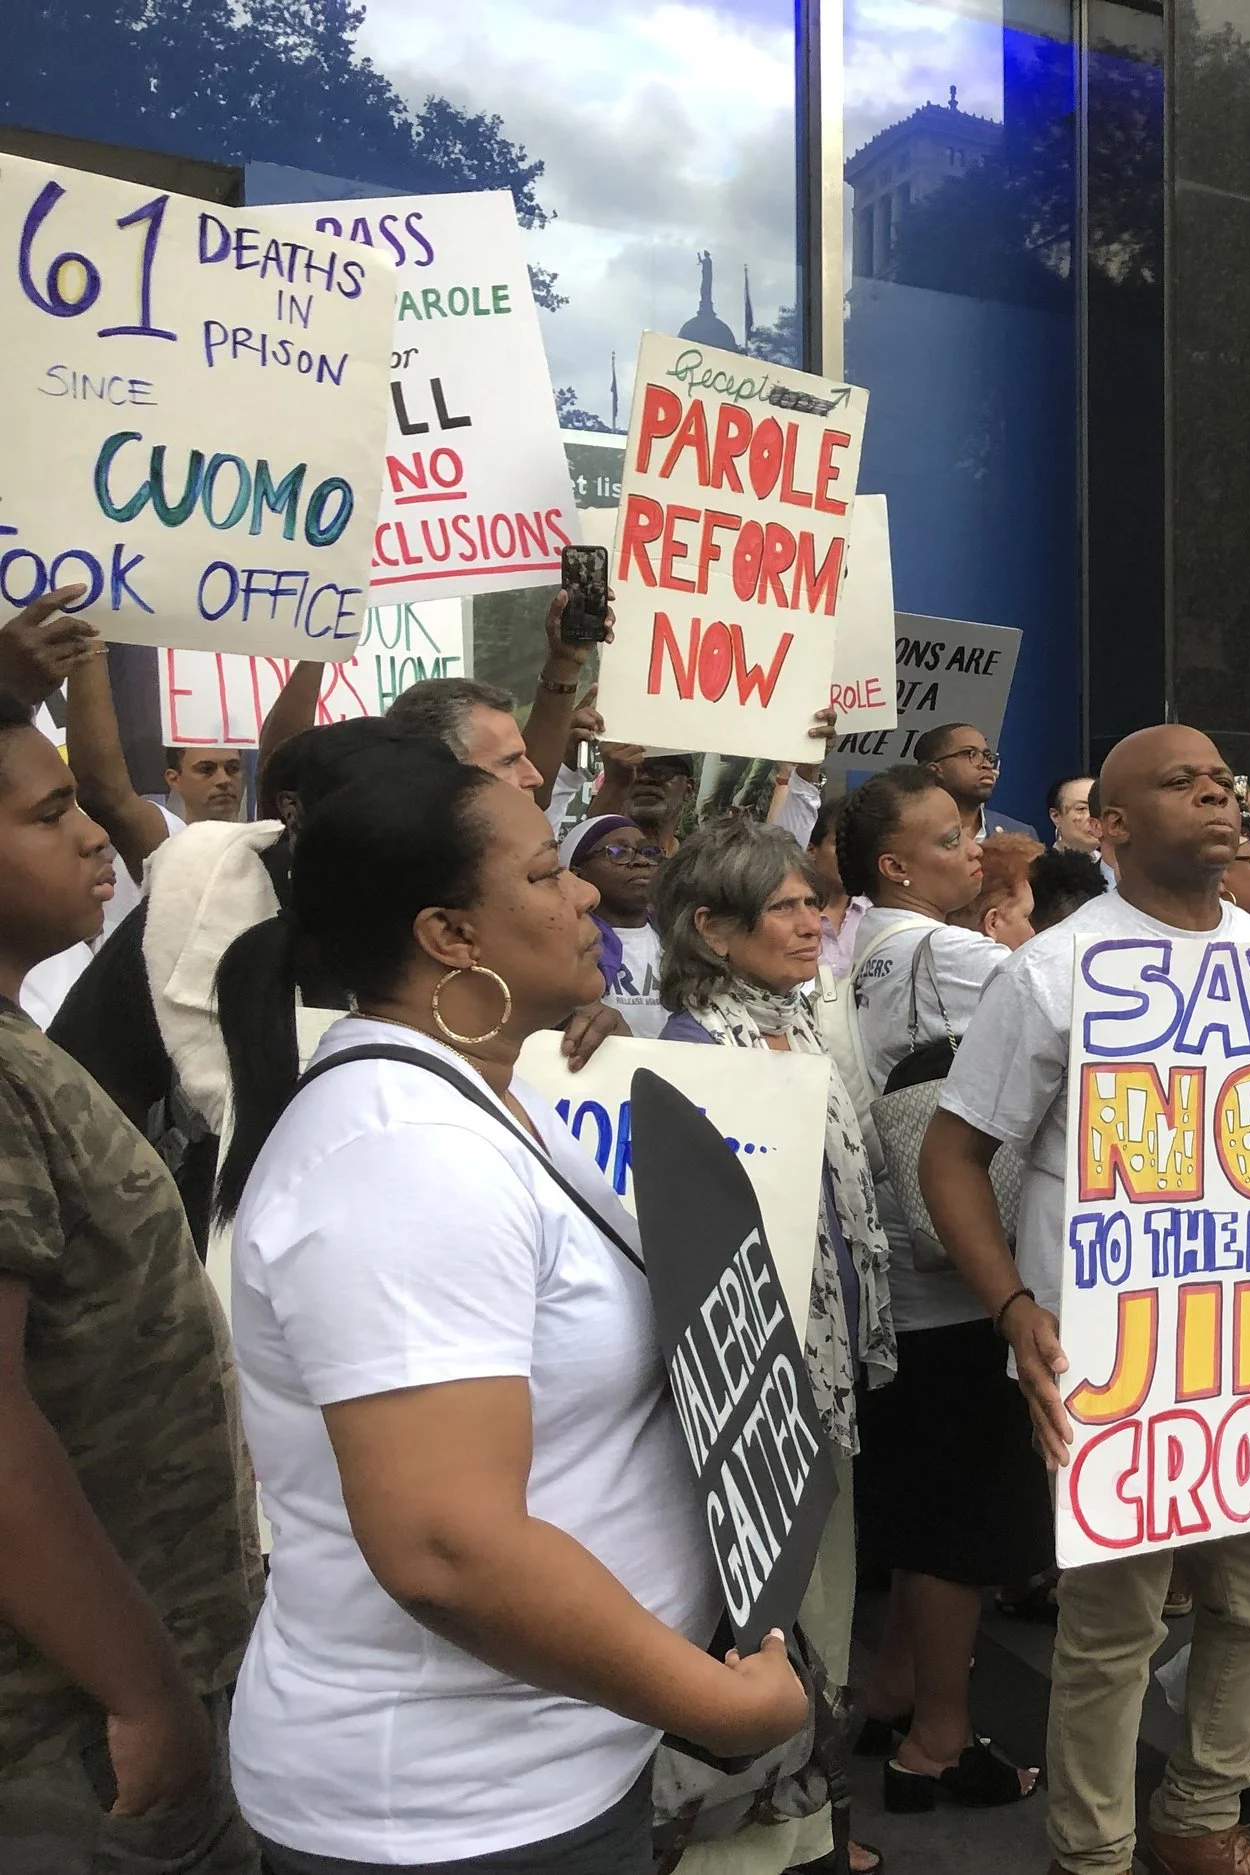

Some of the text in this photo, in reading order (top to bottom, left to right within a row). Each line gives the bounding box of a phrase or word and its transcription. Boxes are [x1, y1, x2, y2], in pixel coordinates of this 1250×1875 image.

[18, 181, 365, 341] 61 DEATHS
[277, 289, 313, 328] IN
[395, 284, 512, 321] AROLE
[38, 365, 158, 405] SINCE
[204, 320, 348, 386] PRISON
[386, 447, 463, 492] NO
[636, 383, 851, 516] PAROLE
[94, 431, 354, 547] CUOMO
[372, 508, 571, 567] CLUSIONS
[618, 494, 845, 617] REFORM
[0, 526, 363, 639] OOK OFFICE
[647, 611, 795, 708] NOW
[917, 682, 939, 711] A
[945, 645, 1002, 676] ARE
[1070, 1210, 1131, 1288] TO
[670, 1227, 785, 1478] VALERIE
[706, 1354, 819, 1628] GAITER
